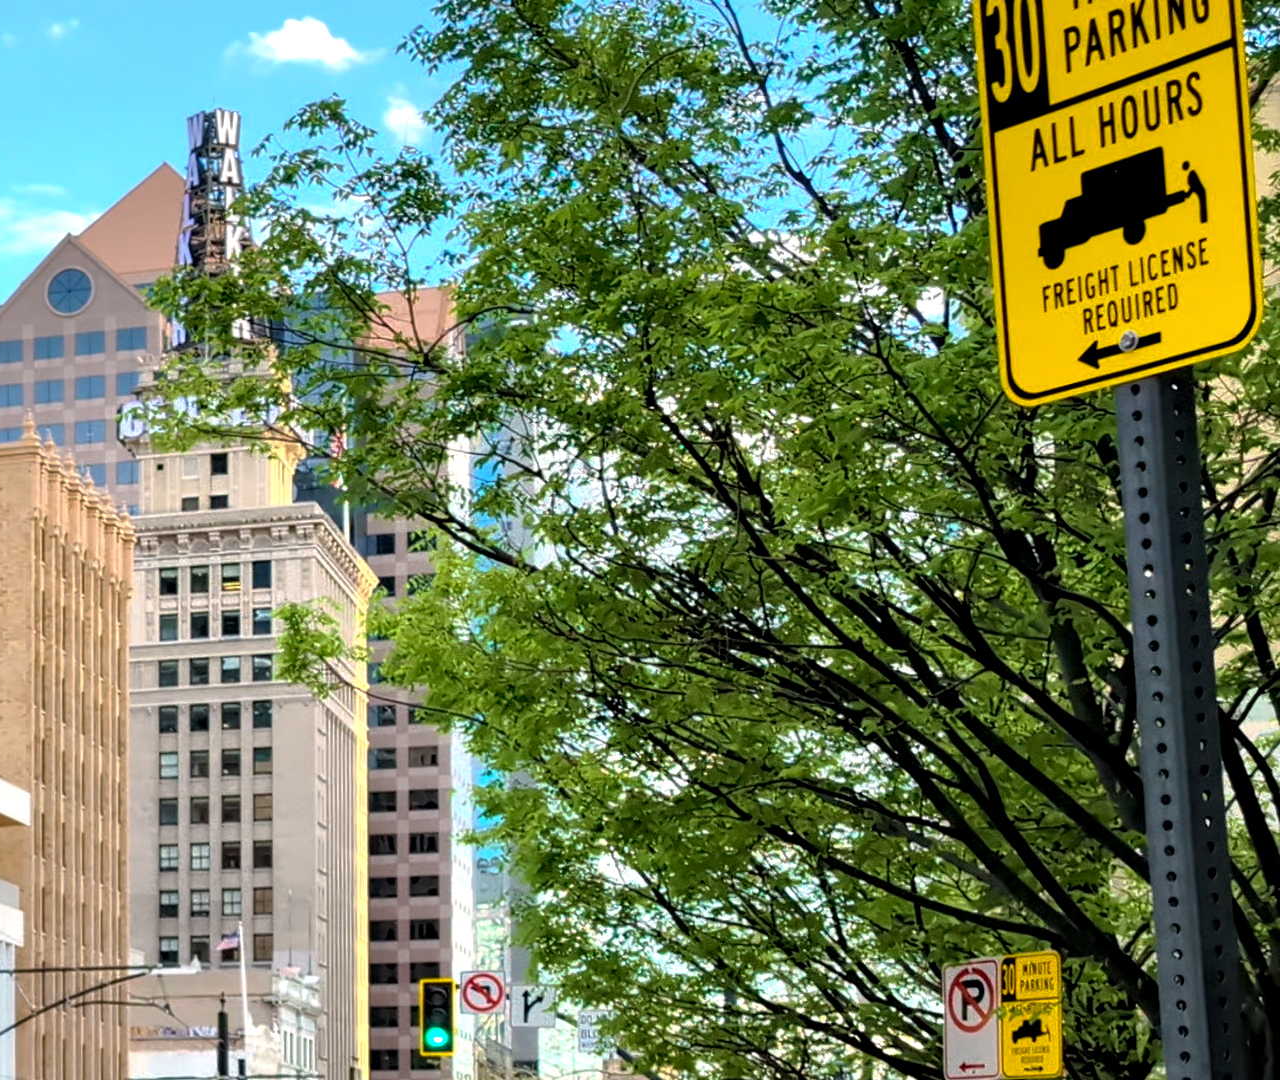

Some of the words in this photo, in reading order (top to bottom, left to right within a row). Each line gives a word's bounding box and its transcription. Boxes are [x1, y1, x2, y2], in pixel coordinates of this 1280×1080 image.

[986, 0, 1040, 103] 30
[1064, 0, 1210, 74] PARKING
[1031, 116, 1085, 172] ALL
[1099, 71, 1203, 148] HOURS
[1042, 264, 1119, 313] FREIGHT
[1128, 237, 1209, 287] LICENSE
[1083, 283, 1179, 335] REQUIRED
[1002, 963, 1015, 996] 30
[1020, 977, 1054, 993] PARKING
[1022, 961, 1051, 976] MINUTE
